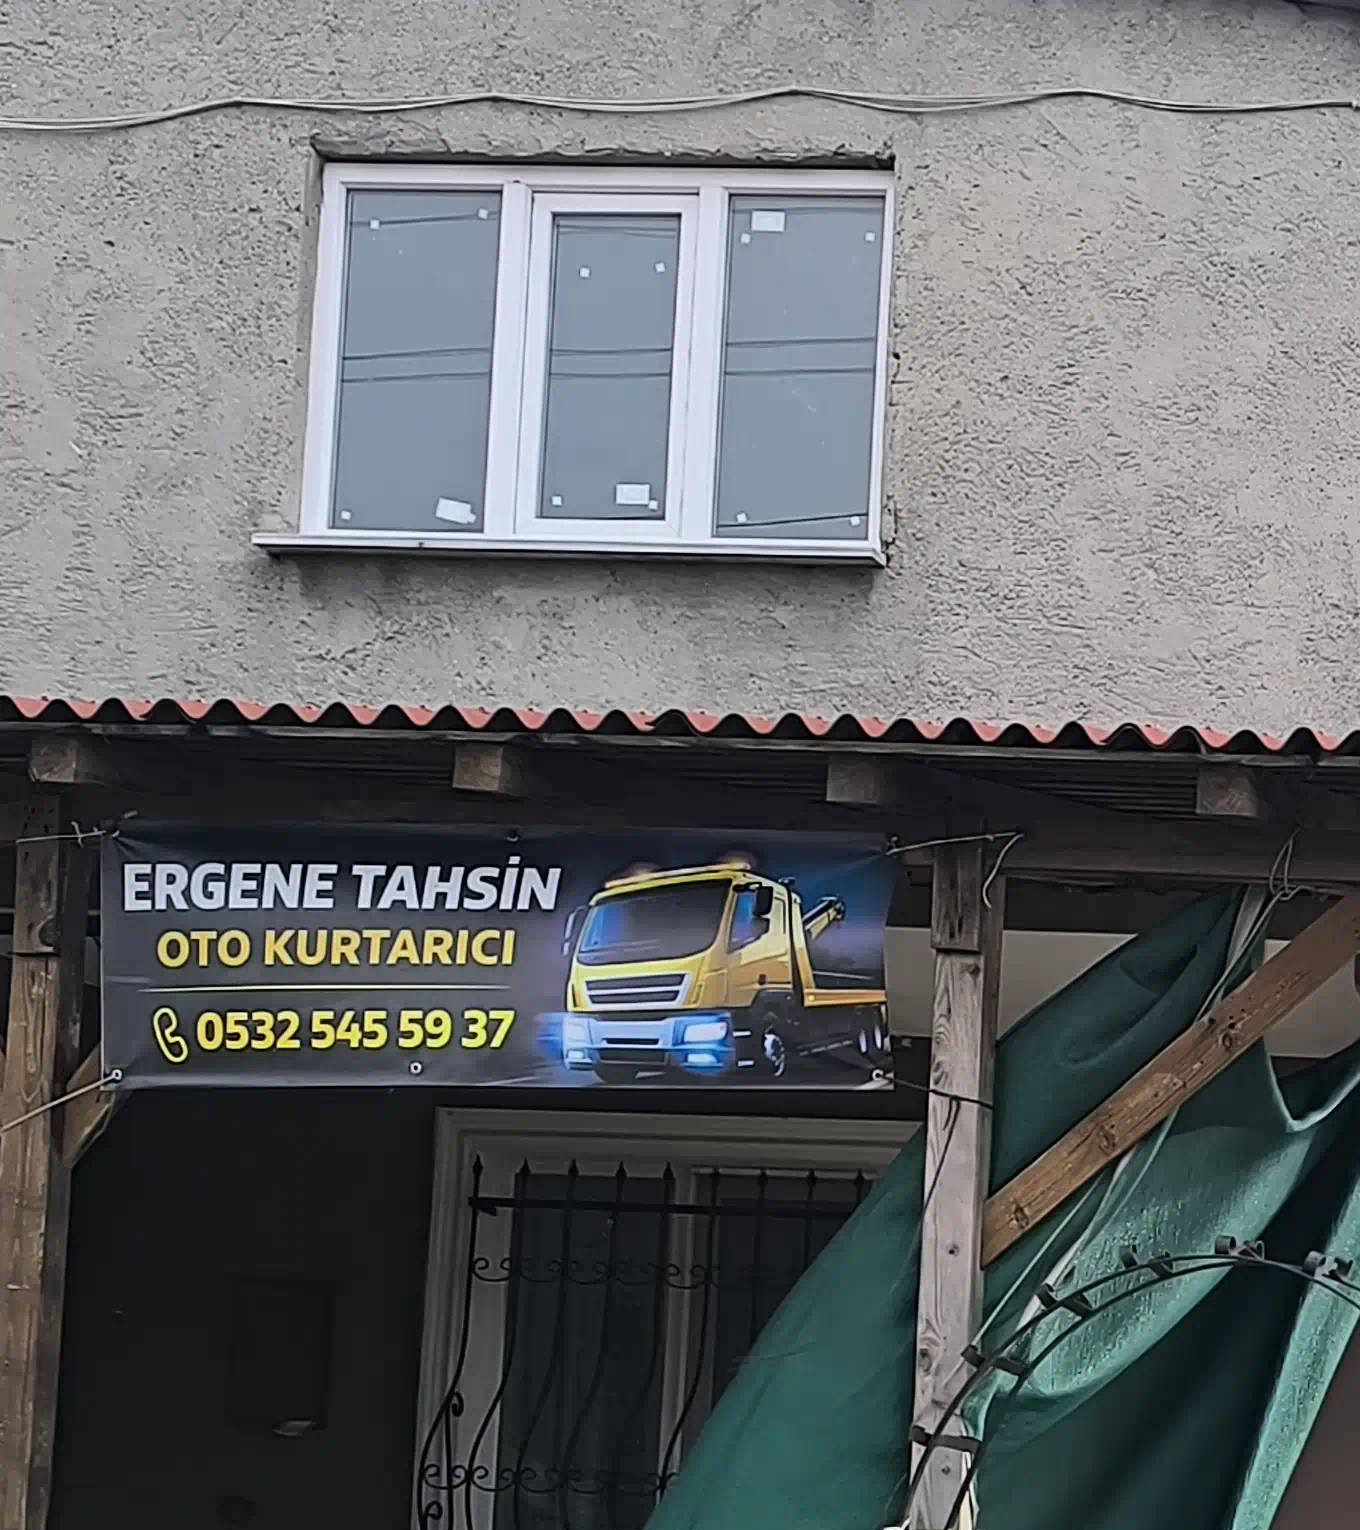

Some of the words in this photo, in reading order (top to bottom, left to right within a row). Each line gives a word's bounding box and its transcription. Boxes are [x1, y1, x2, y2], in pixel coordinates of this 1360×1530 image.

[124, 863, 338, 911] ERGENE
[352, 856, 561, 910] TAHSİN
[157, 929, 251, 968] OTO
[264, 929, 515, 966] KURTARICI
[197, 1010, 300, 1050] 0532
[311, 1010, 388, 1049] 545
[398, 1009, 452, 1049] 59
[461, 1009, 515, 1049] 37
